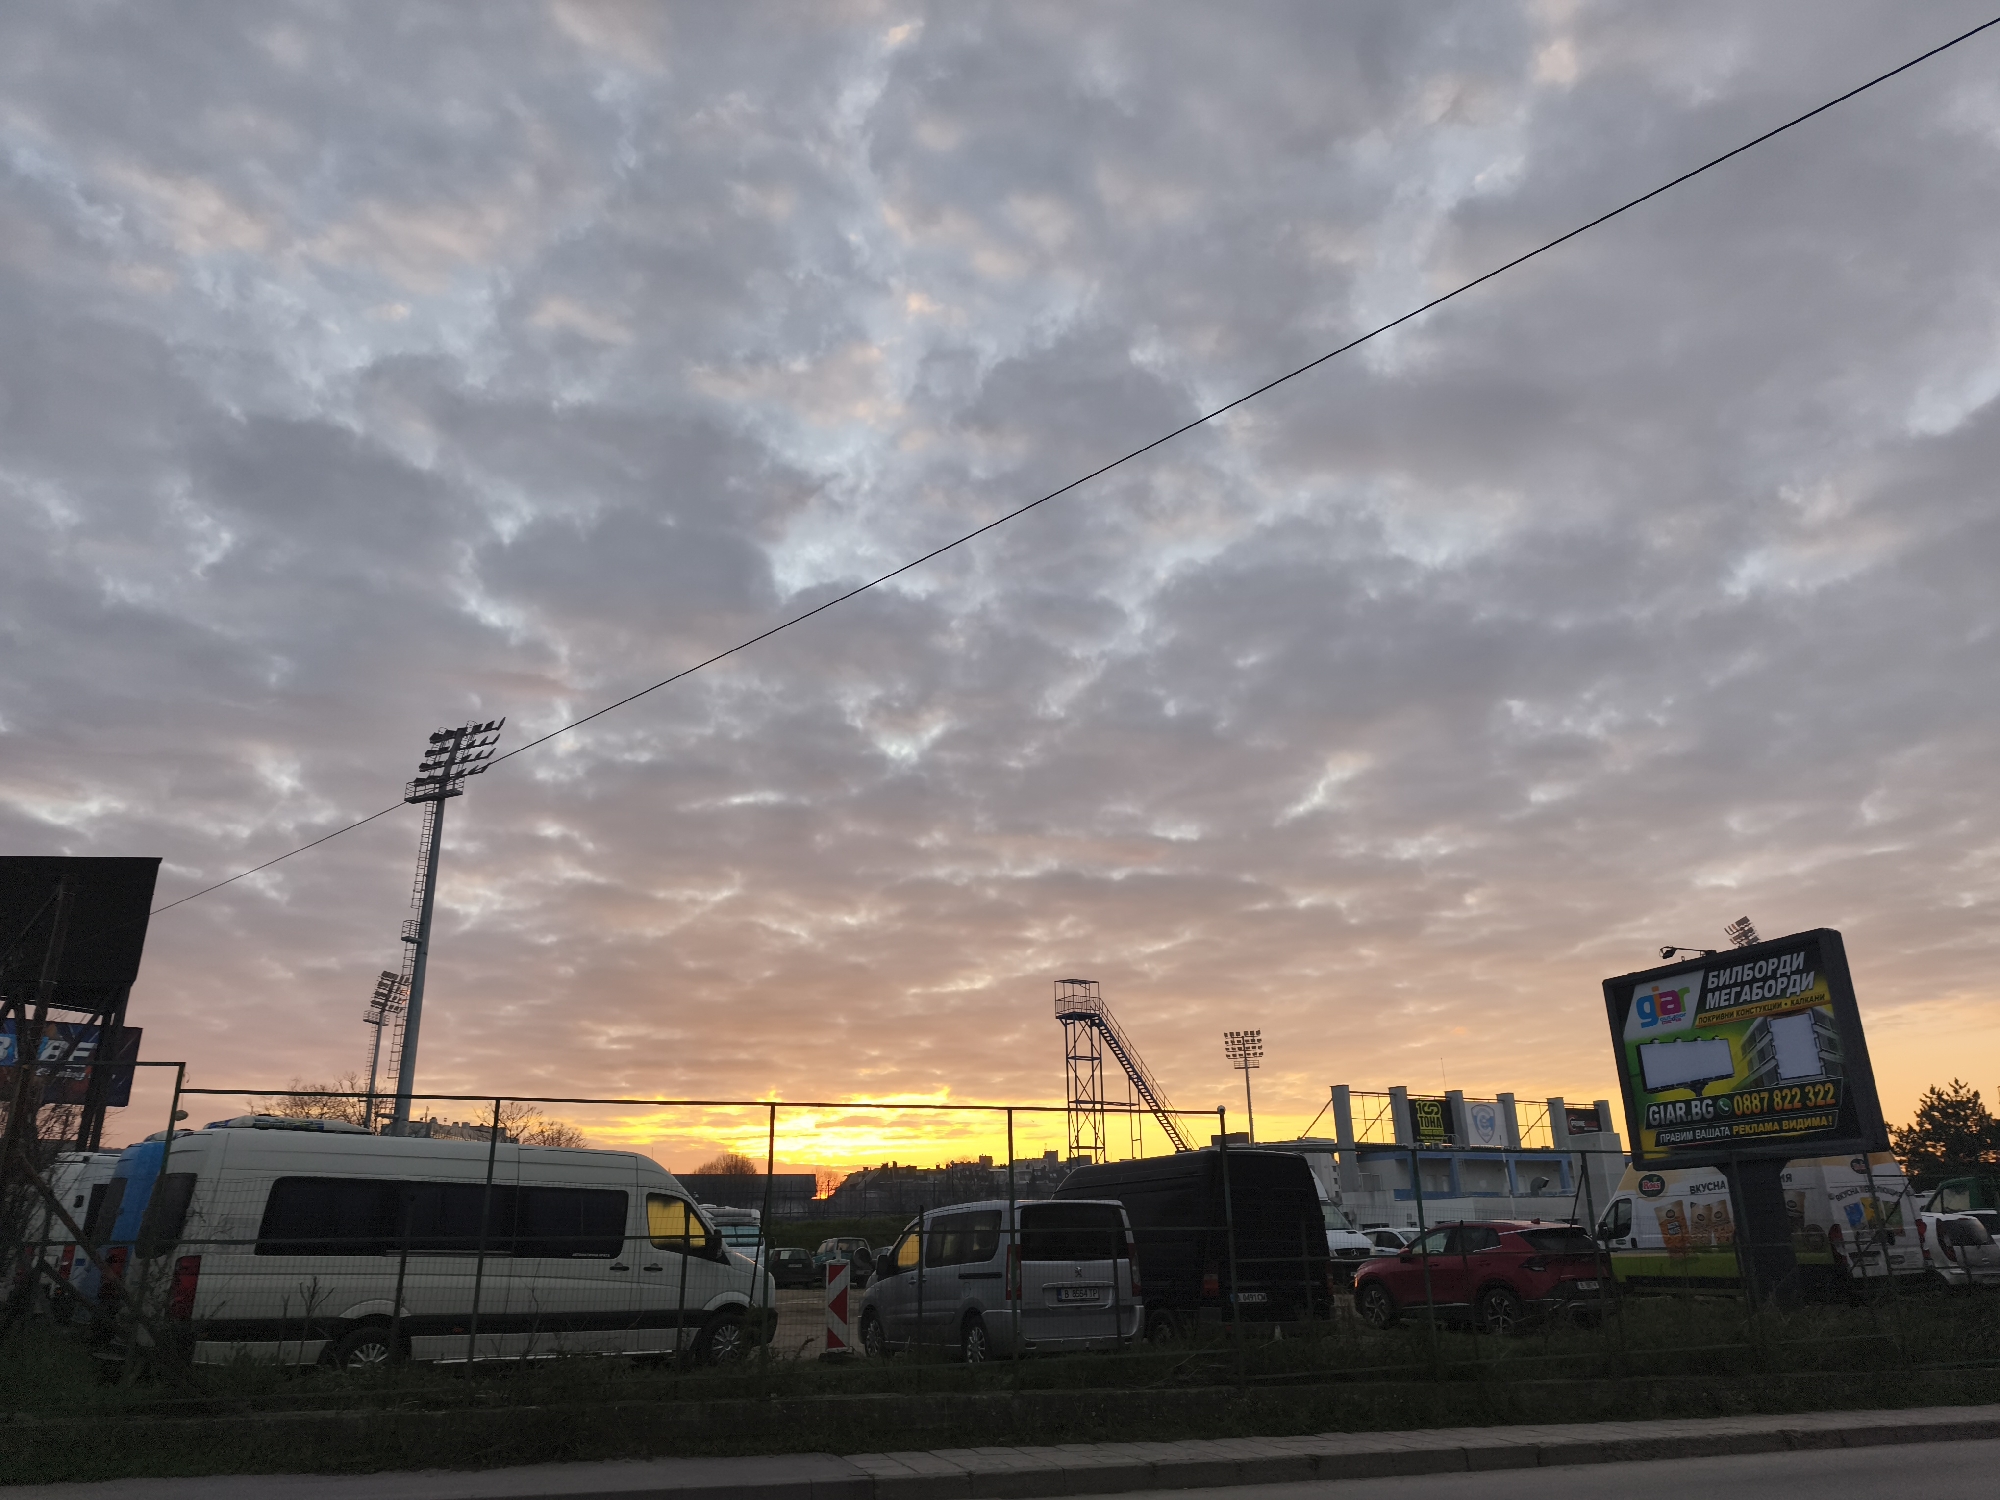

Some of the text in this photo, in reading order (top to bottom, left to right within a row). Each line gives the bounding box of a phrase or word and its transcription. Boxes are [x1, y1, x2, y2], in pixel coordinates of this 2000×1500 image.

[1707, 952, 1805, 989] БИЛБОРДИ
[1636, 986, 1690, 1028] giar
[1705, 971, 1815, 1010] МЕГАБОРДИ
[1698, 1011, 1734, 1024] ПОКРИВНИ
[1648, 1082, 1836, 1126] GIAR.BG 0887 822 322
[1659, 1131, 1694, 1144] ПРАВИМ
[1695, 1128, 1731, 1140] ВАШАТА
[1732, 1123, 1780, 1136] РЕКЛАМА
[1689, 1180, 1727, 1194] ВКУСНА
